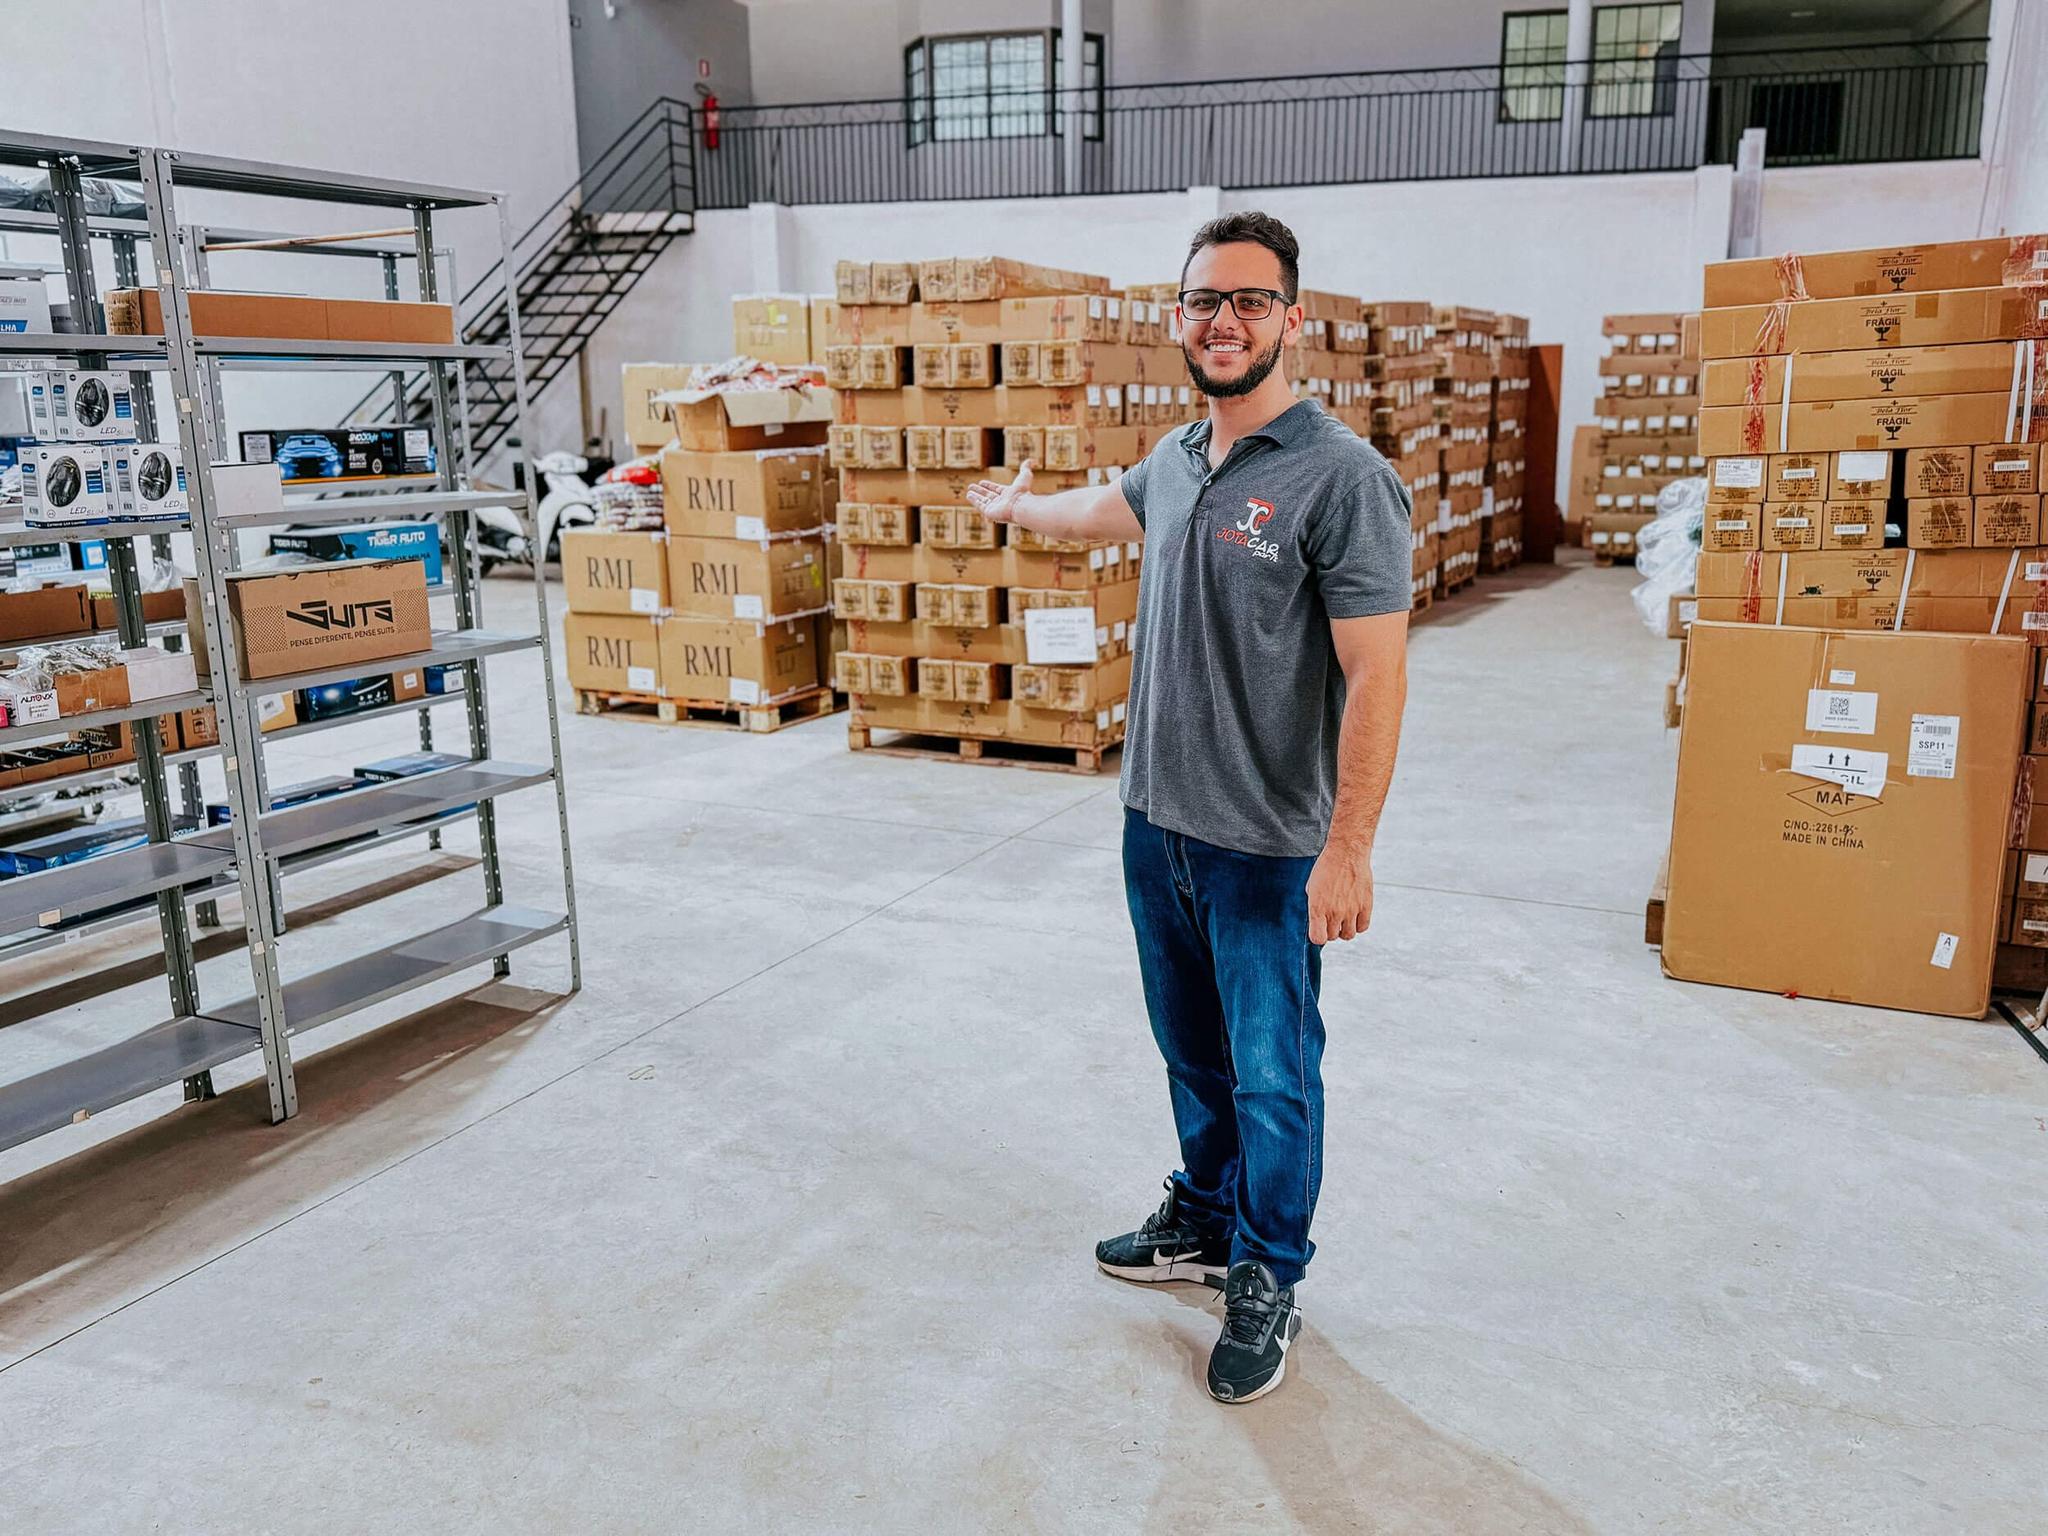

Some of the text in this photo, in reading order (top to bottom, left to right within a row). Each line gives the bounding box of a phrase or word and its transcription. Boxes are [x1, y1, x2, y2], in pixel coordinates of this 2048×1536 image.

[1881, 267, 1917, 277] FRÁGIL
[1865, 316, 1901, 327] FRÁGIL
[1870, 367, 1906, 378] FRÁGIL
[1876, 416, 1912, 426] FRÁGIL
[100, 427, 117, 435] LED
[687, 476, 737, 512] RMI
[69, 506, 87, 515] LED
[366, 534, 398, 547] TIGER
[586, 556, 633, 590] RMI
[691, 561, 740, 596] RMI
[1857, 568, 1891, 578] FRÁGIL
[1874, 617, 1909, 626] FRÁL
[290, 626, 395, 648] PENSE DIFERENTE, PENSE SUITS
[586, 635, 633, 669] RMI
[683, 644, 733, 678] RMI
[1816, 791, 1857, 806] MAF
[1782, 832, 1864, 849] MADE IN CHINA
[1944, 937, 1952, 947] A
